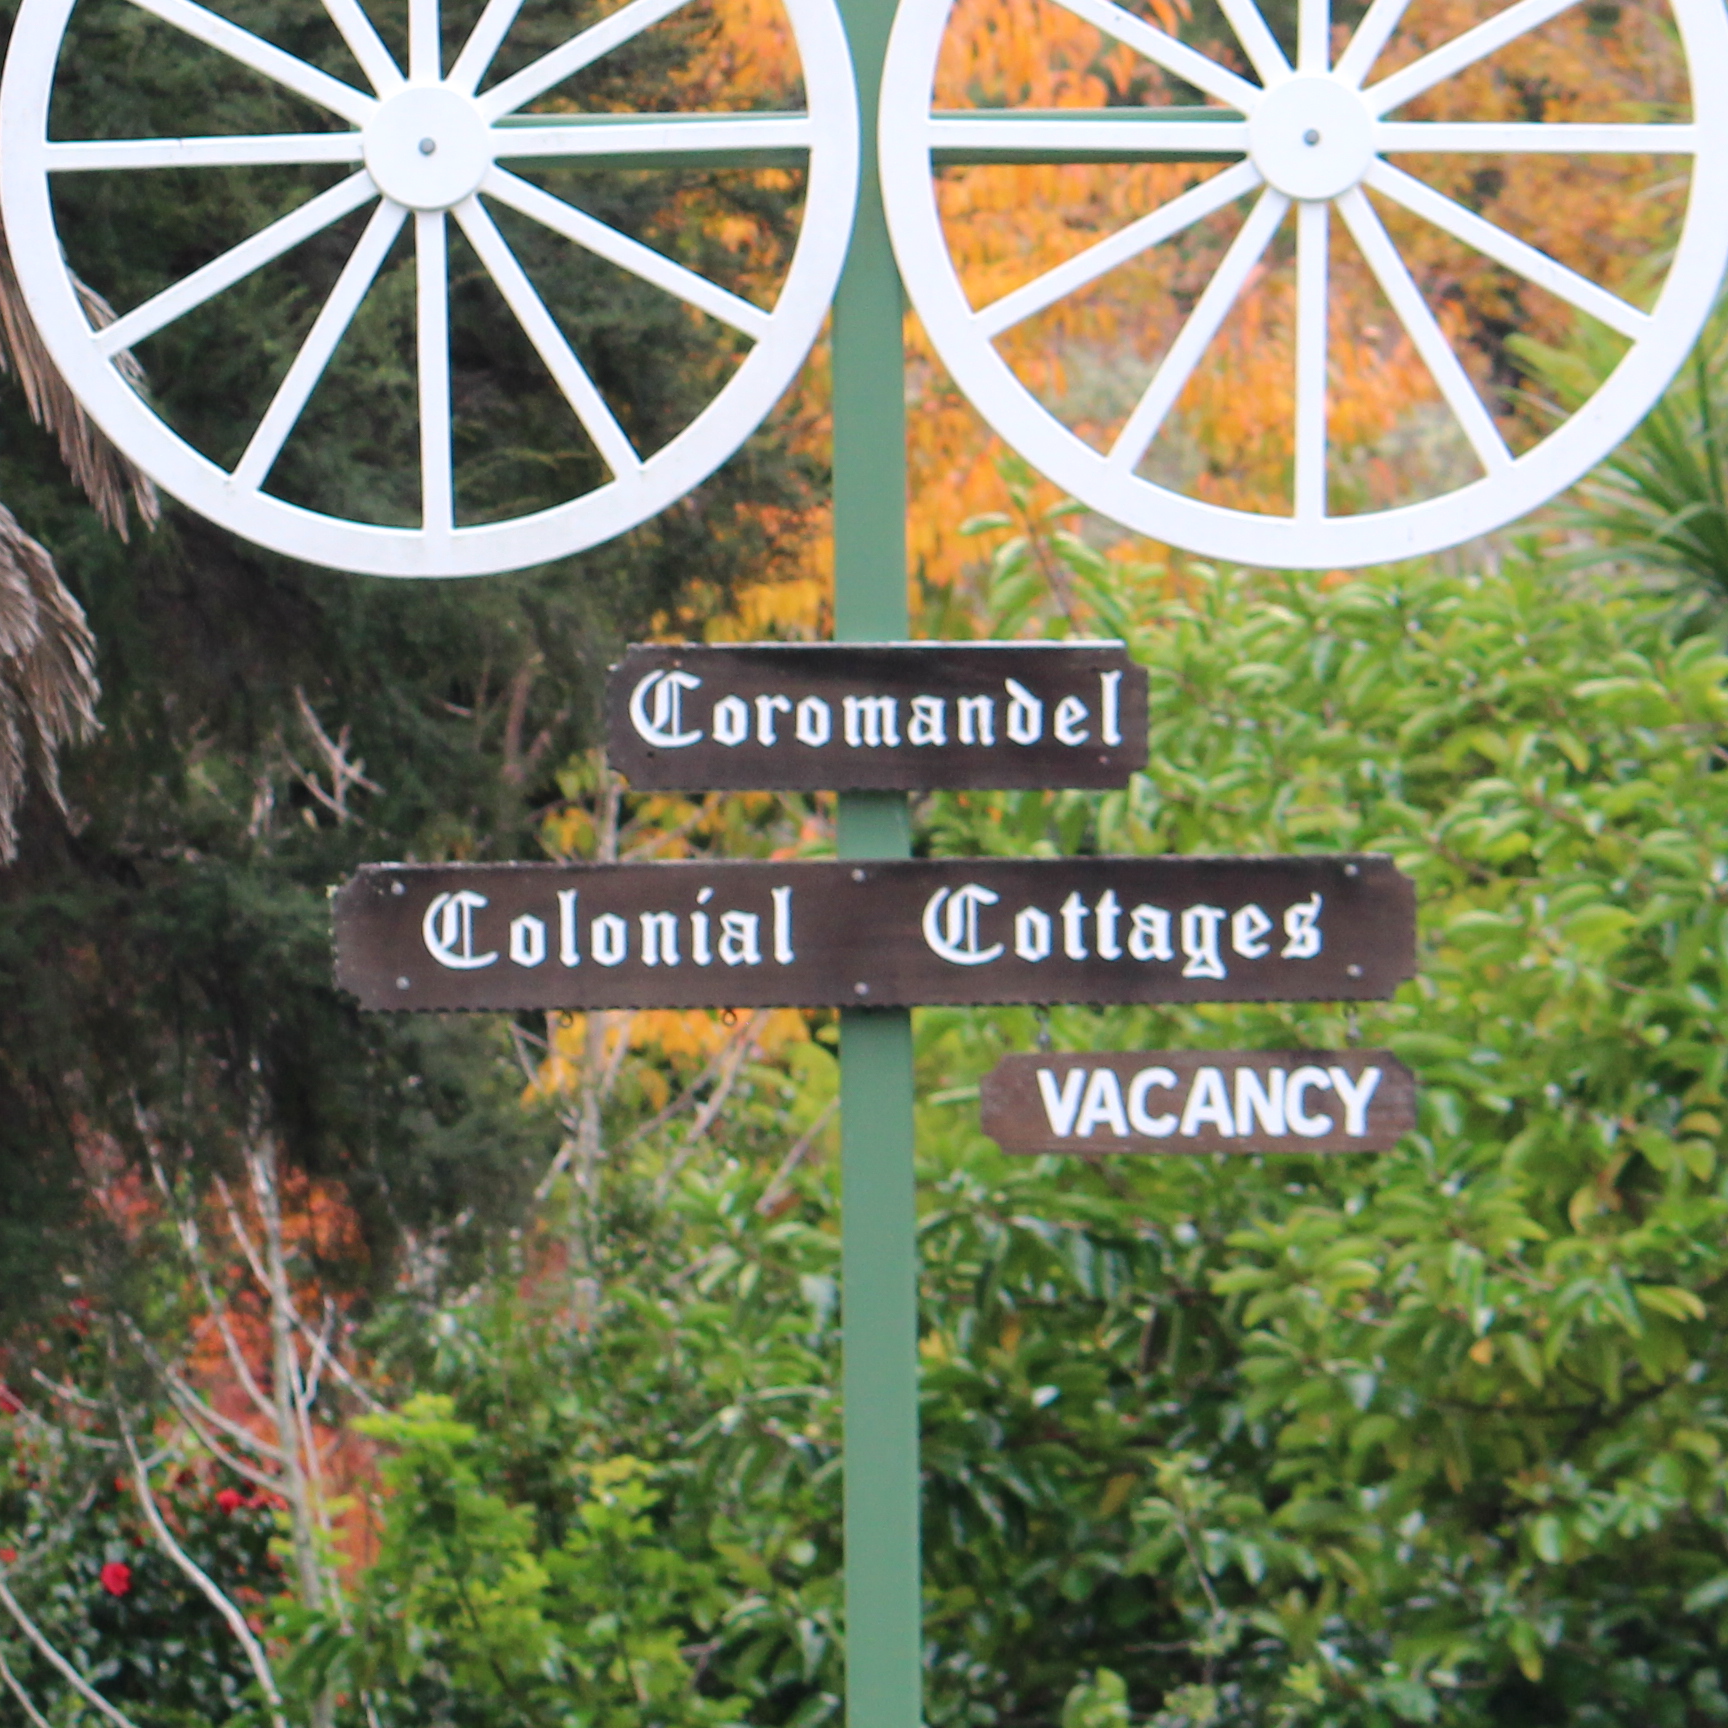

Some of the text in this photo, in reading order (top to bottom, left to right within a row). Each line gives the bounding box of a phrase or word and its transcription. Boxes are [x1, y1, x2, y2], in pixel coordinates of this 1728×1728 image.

[629, 670, 1122, 749] Coromandel
[422, 883, 1323, 980] Colonial Cottages
[1036, 1065, 1381, 1138] VACANCY
